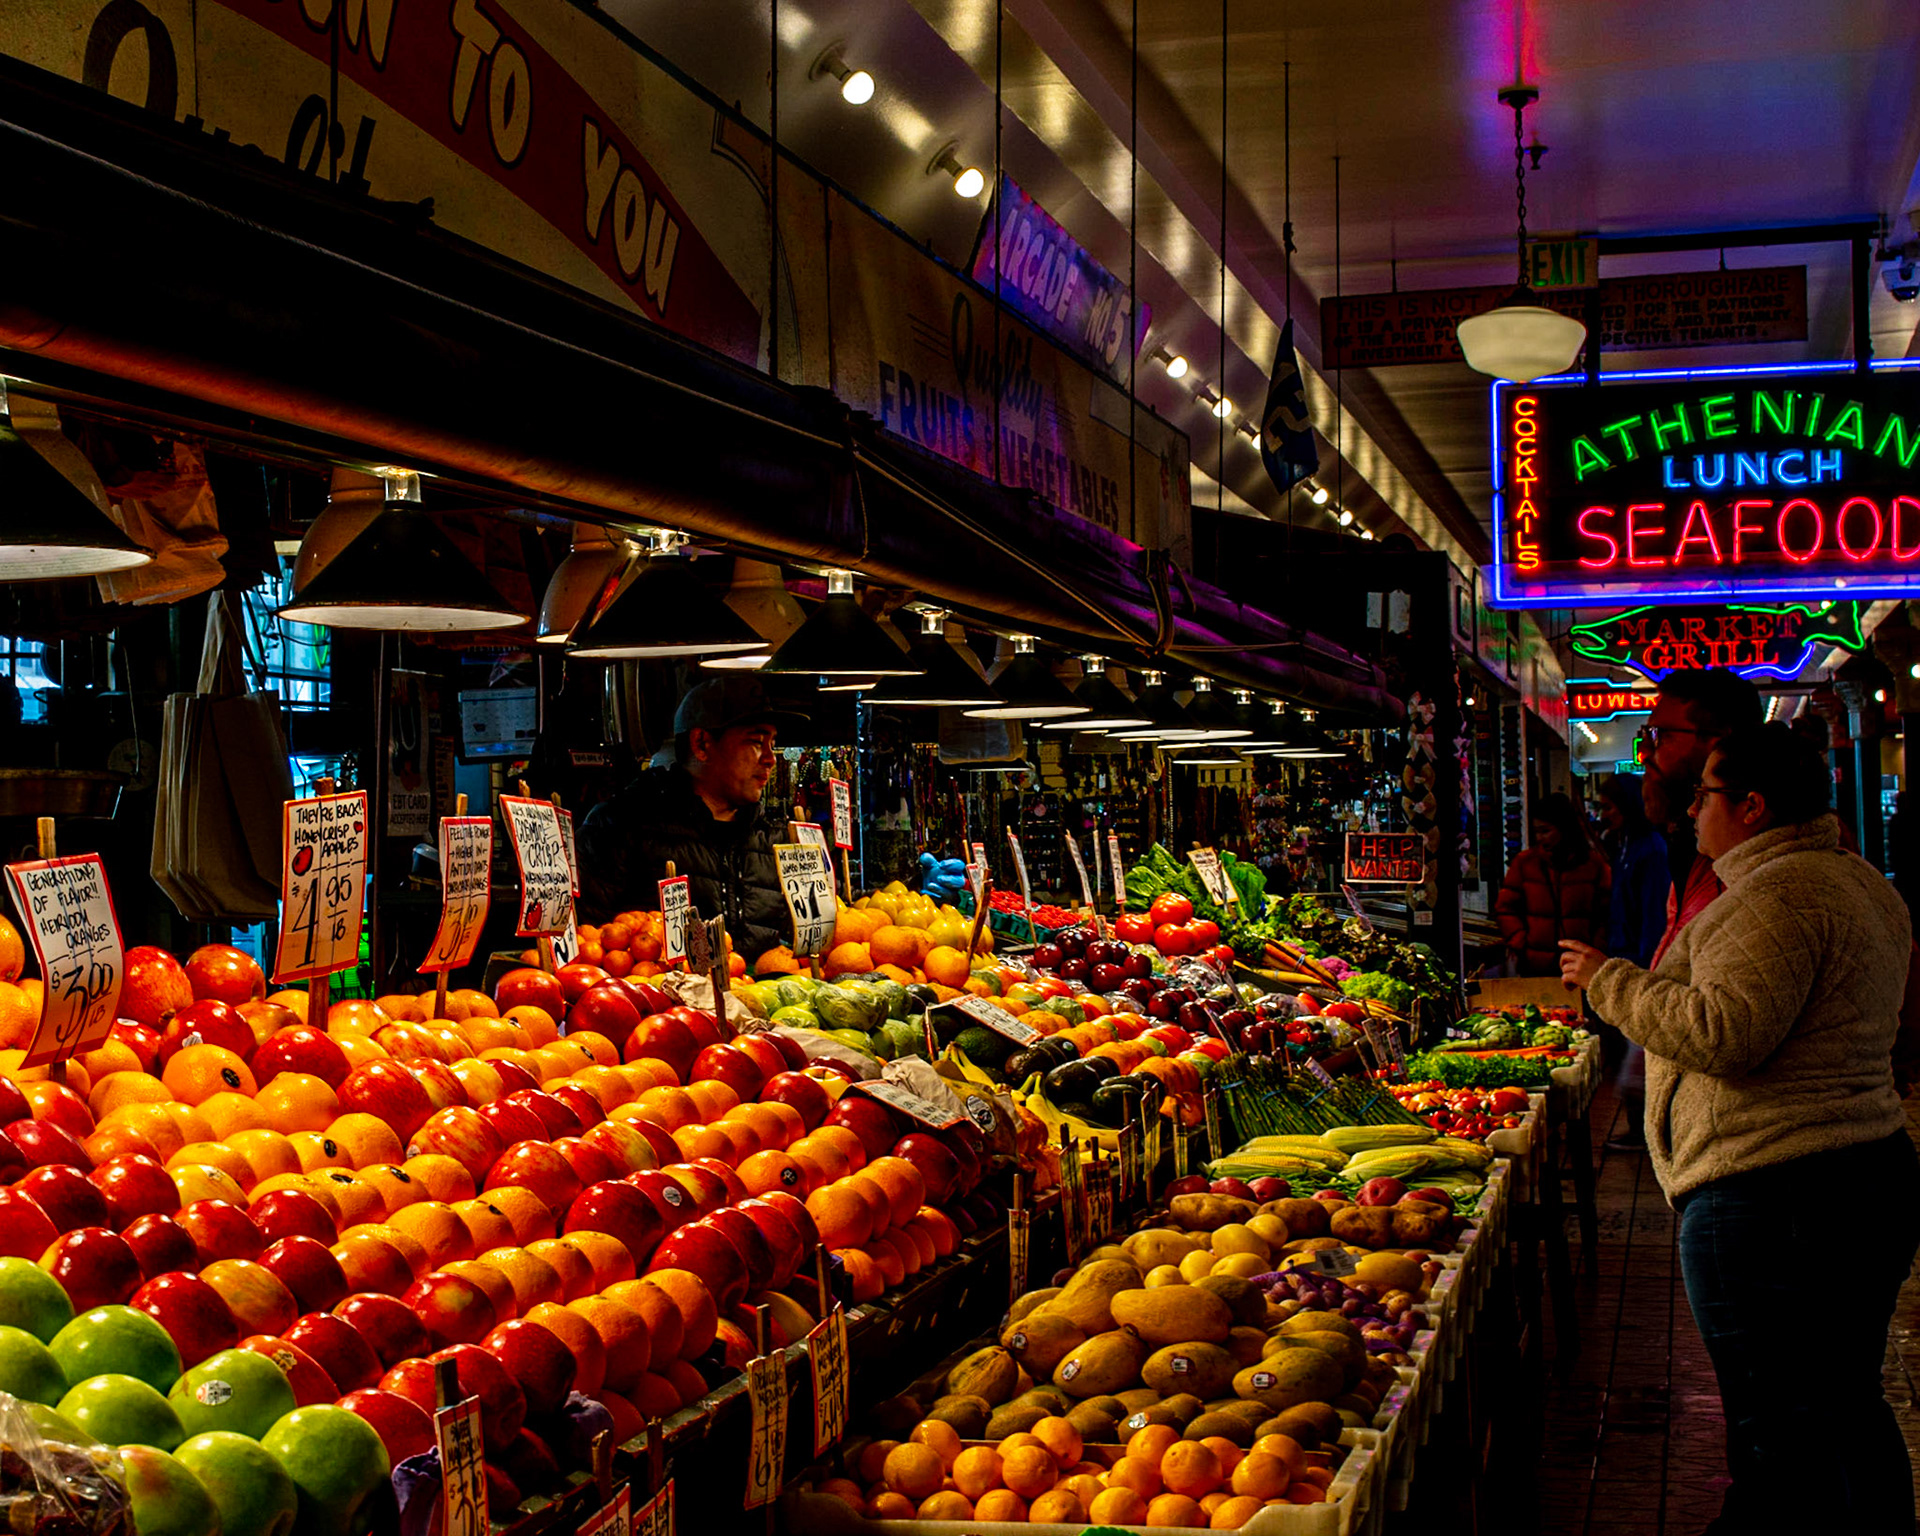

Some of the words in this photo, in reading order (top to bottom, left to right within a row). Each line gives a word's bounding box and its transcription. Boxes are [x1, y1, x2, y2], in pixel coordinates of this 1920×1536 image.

[447, 0, 532, 168] TO
[581, 114, 682, 317] YOU
[989, 206, 1080, 326] ARCADE
[1532, 241, 1588, 287] EXIT
[1337, 300, 1386, 318] THIS
[1399, 298, 1419, 316] IS
[1432, 294, 1481, 314] NOT
[1617, 274, 1790, 302] THOROUGHFARE
[1382, 320, 1393, 332] A
[1634, 302, 1667, 317] FOR
[1672, 299, 1700, 314] THE
[1707, 294, 1785, 311] PATRONS
[1359, 334, 1384, 346] THE
[1391, 331, 1425, 344] PIKE
[1674, 313, 1704, 328] AND
[1708, 311, 1733, 325] THE
[1352, 345, 1442, 361] INVESTMENT
[878, 360, 976, 470] FRUITS
[1001, 425, 1120, 533] VEGETABLES
[1571, 390, 1920, 483] ATHENIAN
[1513, 396, 1541, 571] COCKTAILS
[1662, 448, 1844, 489] LUNCH
[1577, 495, 1920, 568] SEAFOOD
[1617, 612, 1803, 646] MARKET
[1642, 639, 1780, 670] GRILL
[1576, 693, 1658, 711] LOWER
[296, 806, 334, 825] THEY'RE
[407, 794, 428, 809] CARD
[294, 823, 350, 845] HONEYCRISP
[320, 836, 360, 859] APPLES
[1360, 837, 1414, 858] HELP
[529, 843, 563, 873] CRISP
[1350, 858, 1422, 879] WANTED
[26, 862, 96, 891] GENERATIONS
[33, 895, 49, 915] OF
[40, 908, 90, 937] HEIRLOOM
[66, 923, 111, 949] ORANGES
